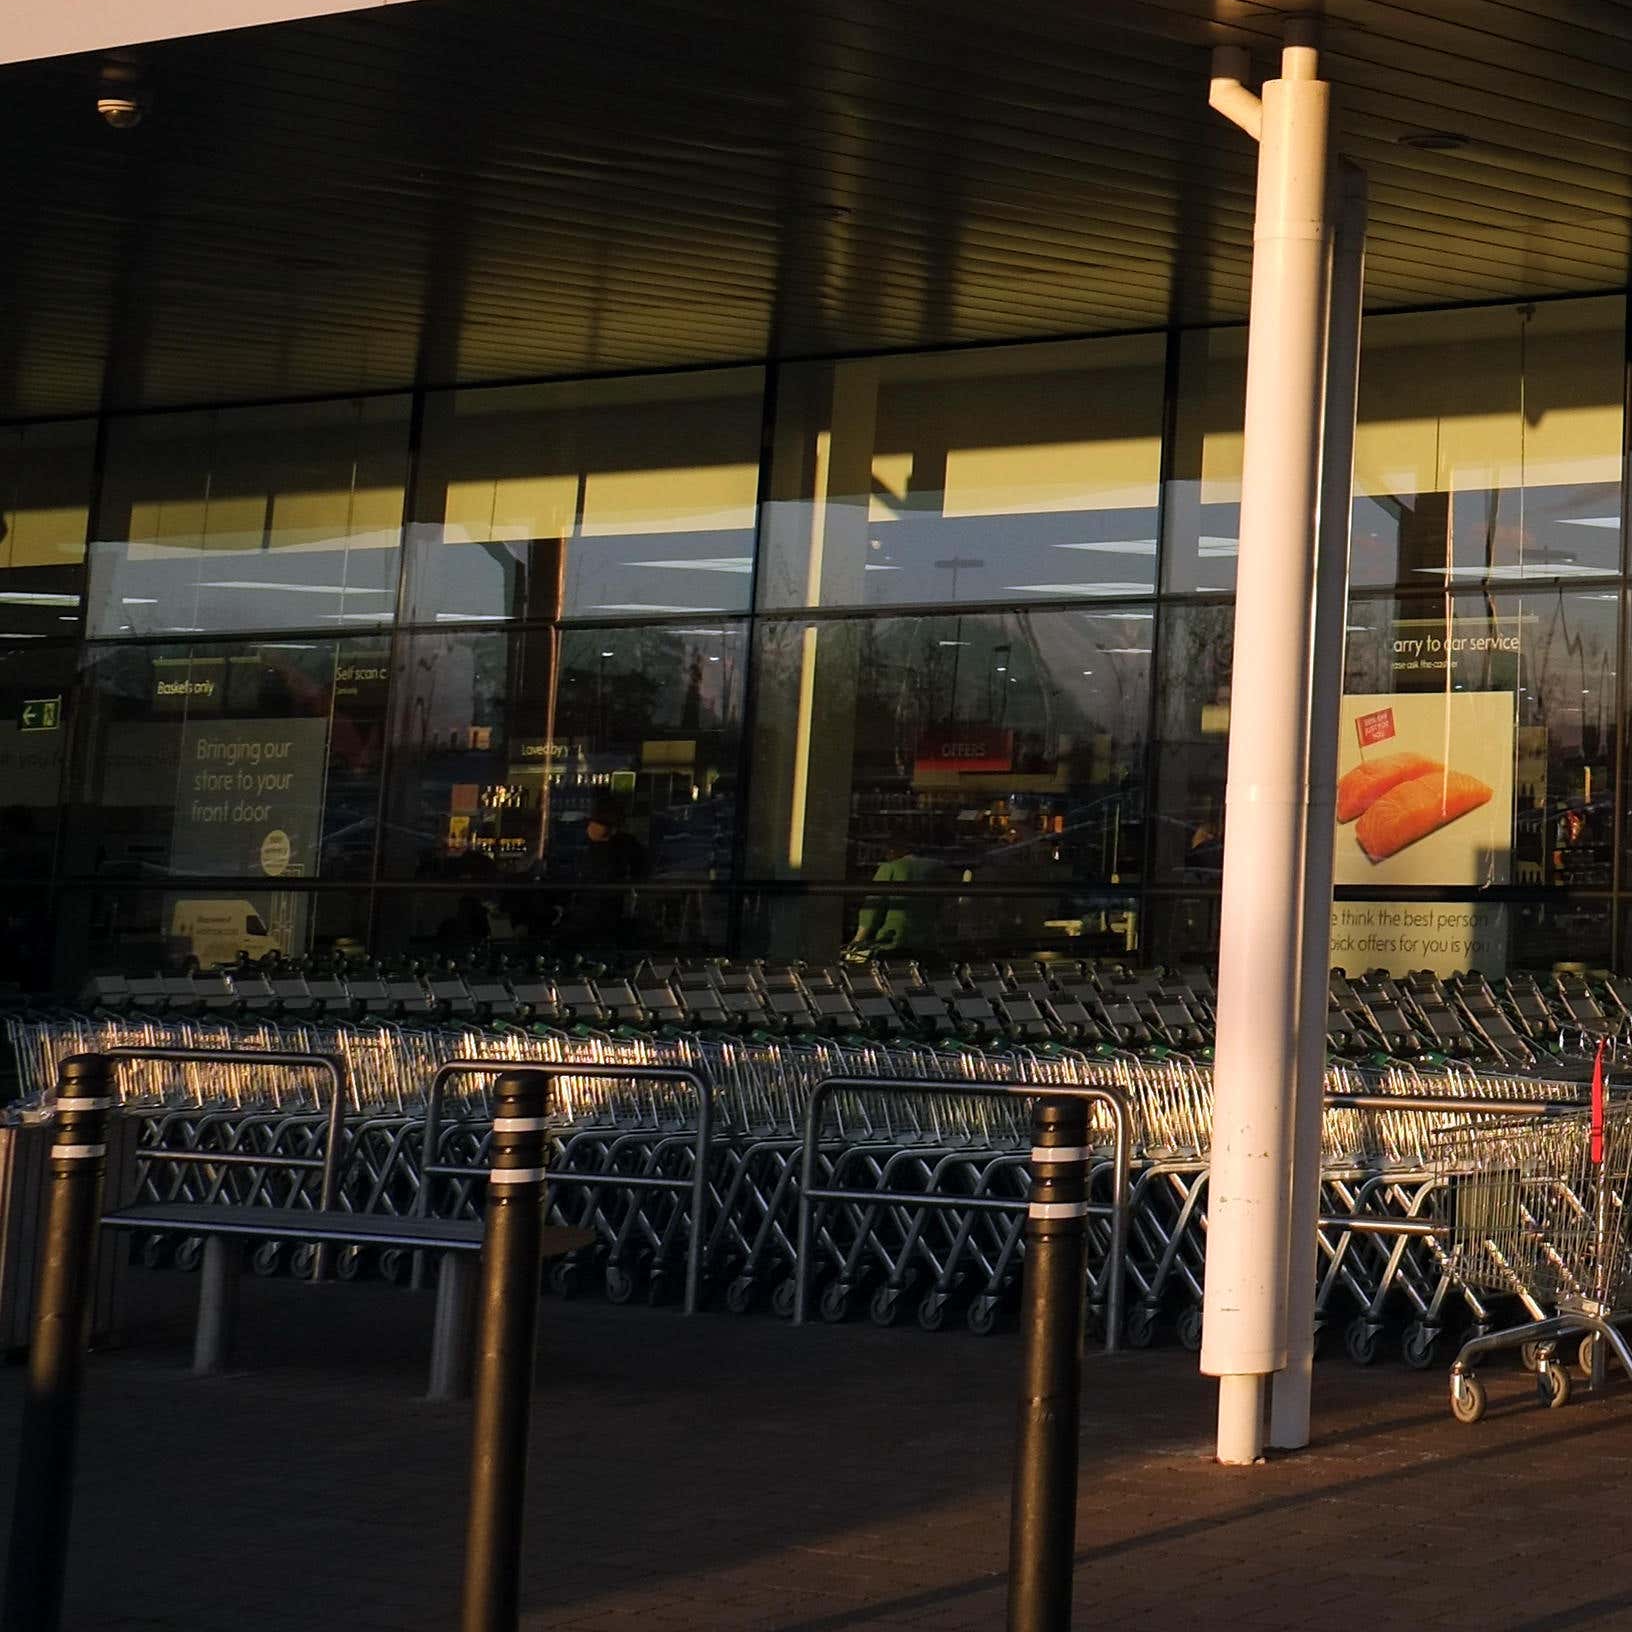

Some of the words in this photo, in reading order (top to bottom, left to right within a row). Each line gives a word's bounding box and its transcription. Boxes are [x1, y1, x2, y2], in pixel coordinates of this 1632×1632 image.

[1393, 639, 1423, 657] arry
[1427, 634, 1441, 652] to
[1470, 632, 1520, 651] service
[193, 679, 214, 696] only
[197, 739, 261, 765] Bringing
[263, 741, 293, 758] our
[942, 742, 986, 757] OFFERS
[194, 774, 234, 792] store
[238, 770, 254, 791] to
[257, 772, 294, 795] your
[191, 802, 231, 822] front
[233, 800, 272, 822] door
[1341, 908, 1374, 926] think
[1378, 908, 1401, 927] the
[1404, 908, 1433, 927] best
[1437, 913, 1489, 932] person
[1357, 934, 1396, 952] offers
[1400, 933, 1418, 952] for
[1422, 939, 1448, 958] you
[1450, 935, 1460, 952] is
